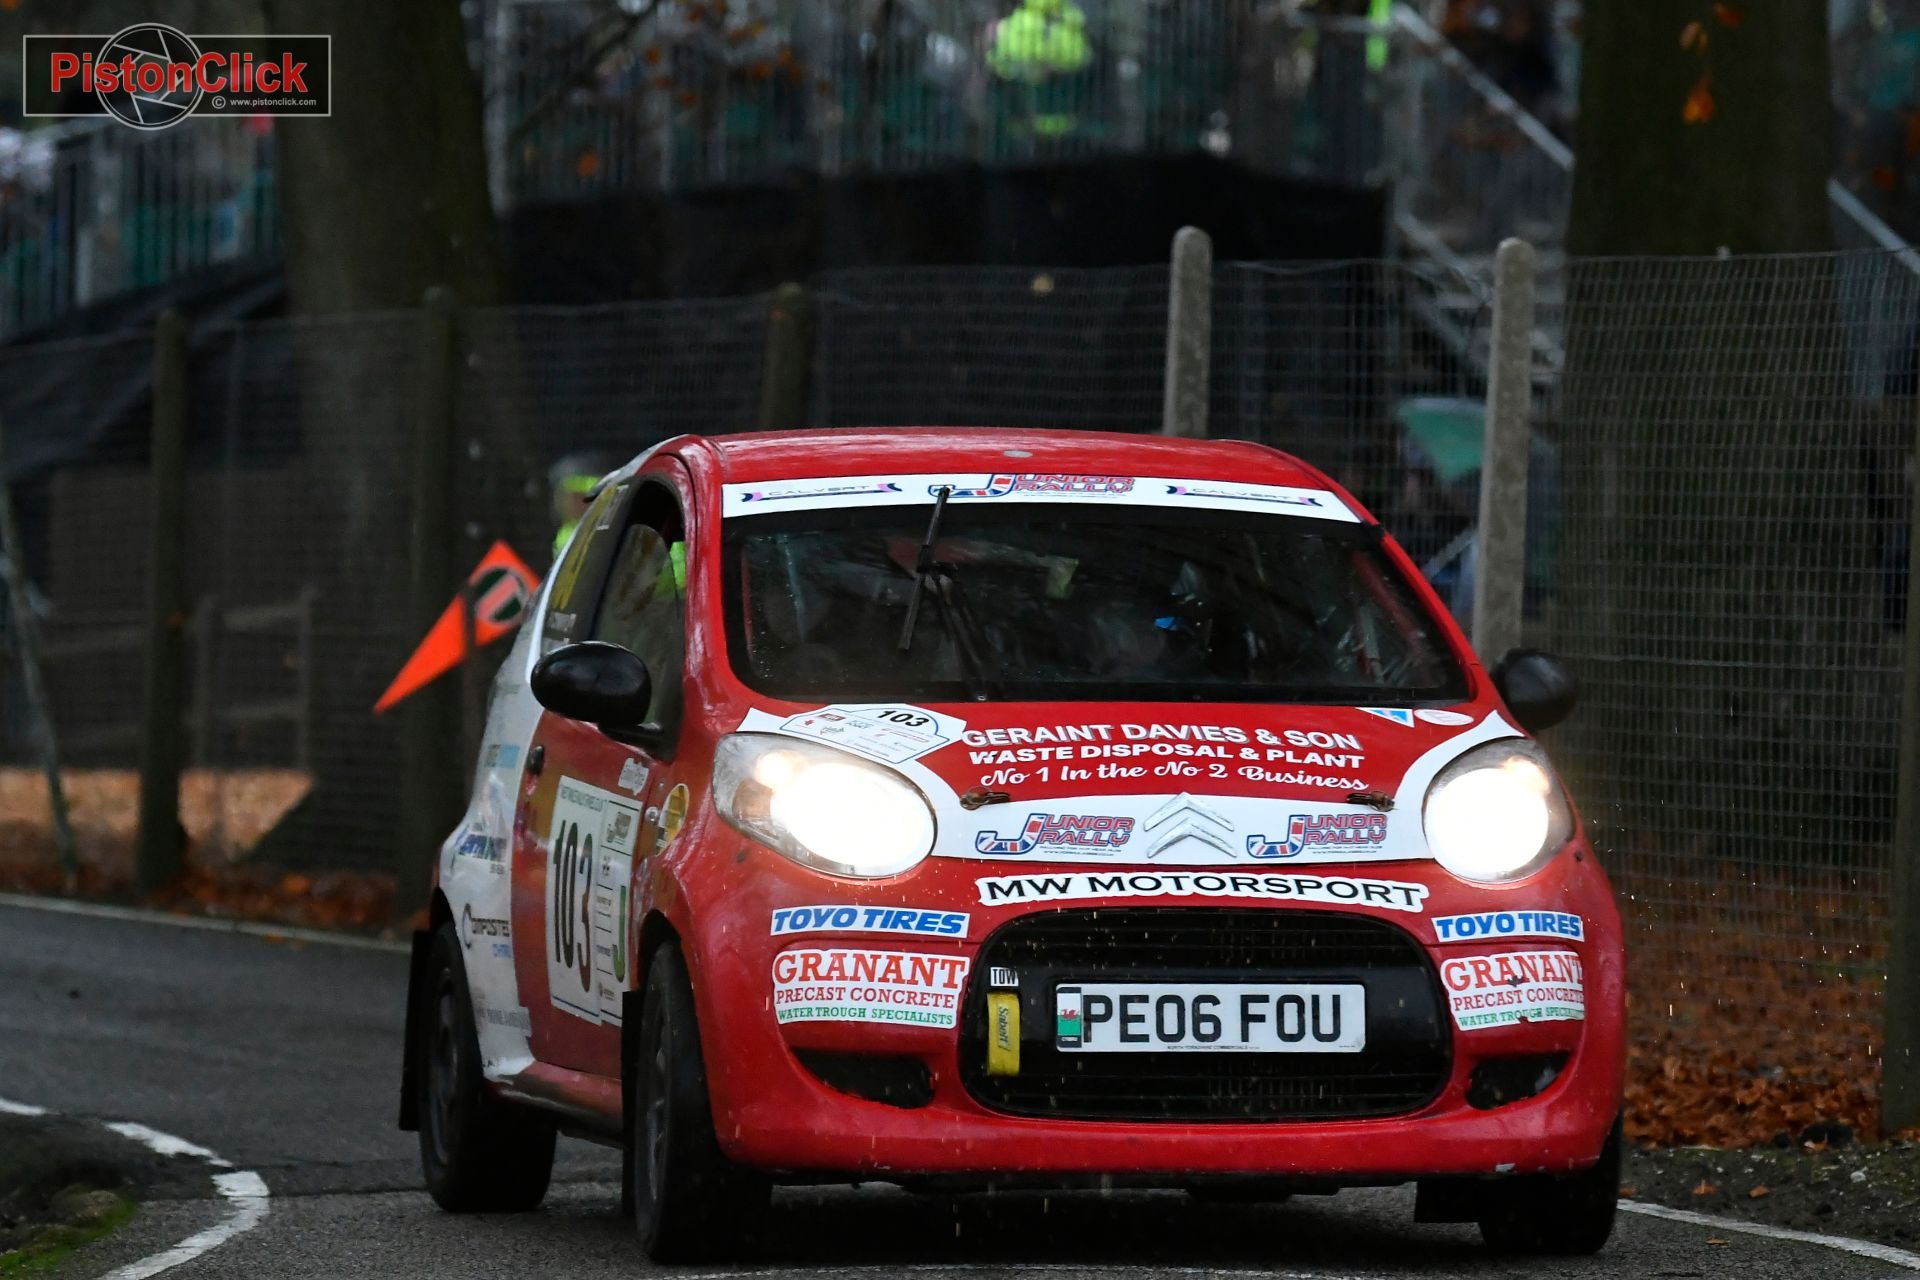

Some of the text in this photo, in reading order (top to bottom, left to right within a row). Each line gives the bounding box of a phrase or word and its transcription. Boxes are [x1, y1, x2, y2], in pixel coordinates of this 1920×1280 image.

[768, 485, 870, 496] CALVERT
[877, 710, 930, 727] 103
[962, 724, 1363, 750] GERAINT DAVIES & SON
[969, 743, 1365, 768] WASTE DISPOSAL & PLANT
[980, 761, 1369, 790] No 1 In the No 2 Business
[1038, 830, 1131, 848] RALLY
[1304, 828, 1387, 845] RALLY
[986, 875, 1420, 907] MW MOTORSPORT
[553, 820, 593, 992] 103
[773, 907, 966, 935] TOYO TIRES
[1436, 913, 1581, 938] TOYO TIRES
[774, 952, 966, 989] GRANANT
[992, 968, 1017, 985] TOW
[1444, 955, 1583, 991] GRANANT
[775, 987, 955, 1009] PRECAST CONCRETE
[1453, 990, 1524, 1011] PRECAST
[778, 1006, 953, 1025] WATER TROUGH SPECIALISTS
[1083, 994, 1341, 1043] PE06 FOU
[1458, 1012, 1498, 1028] WATER
